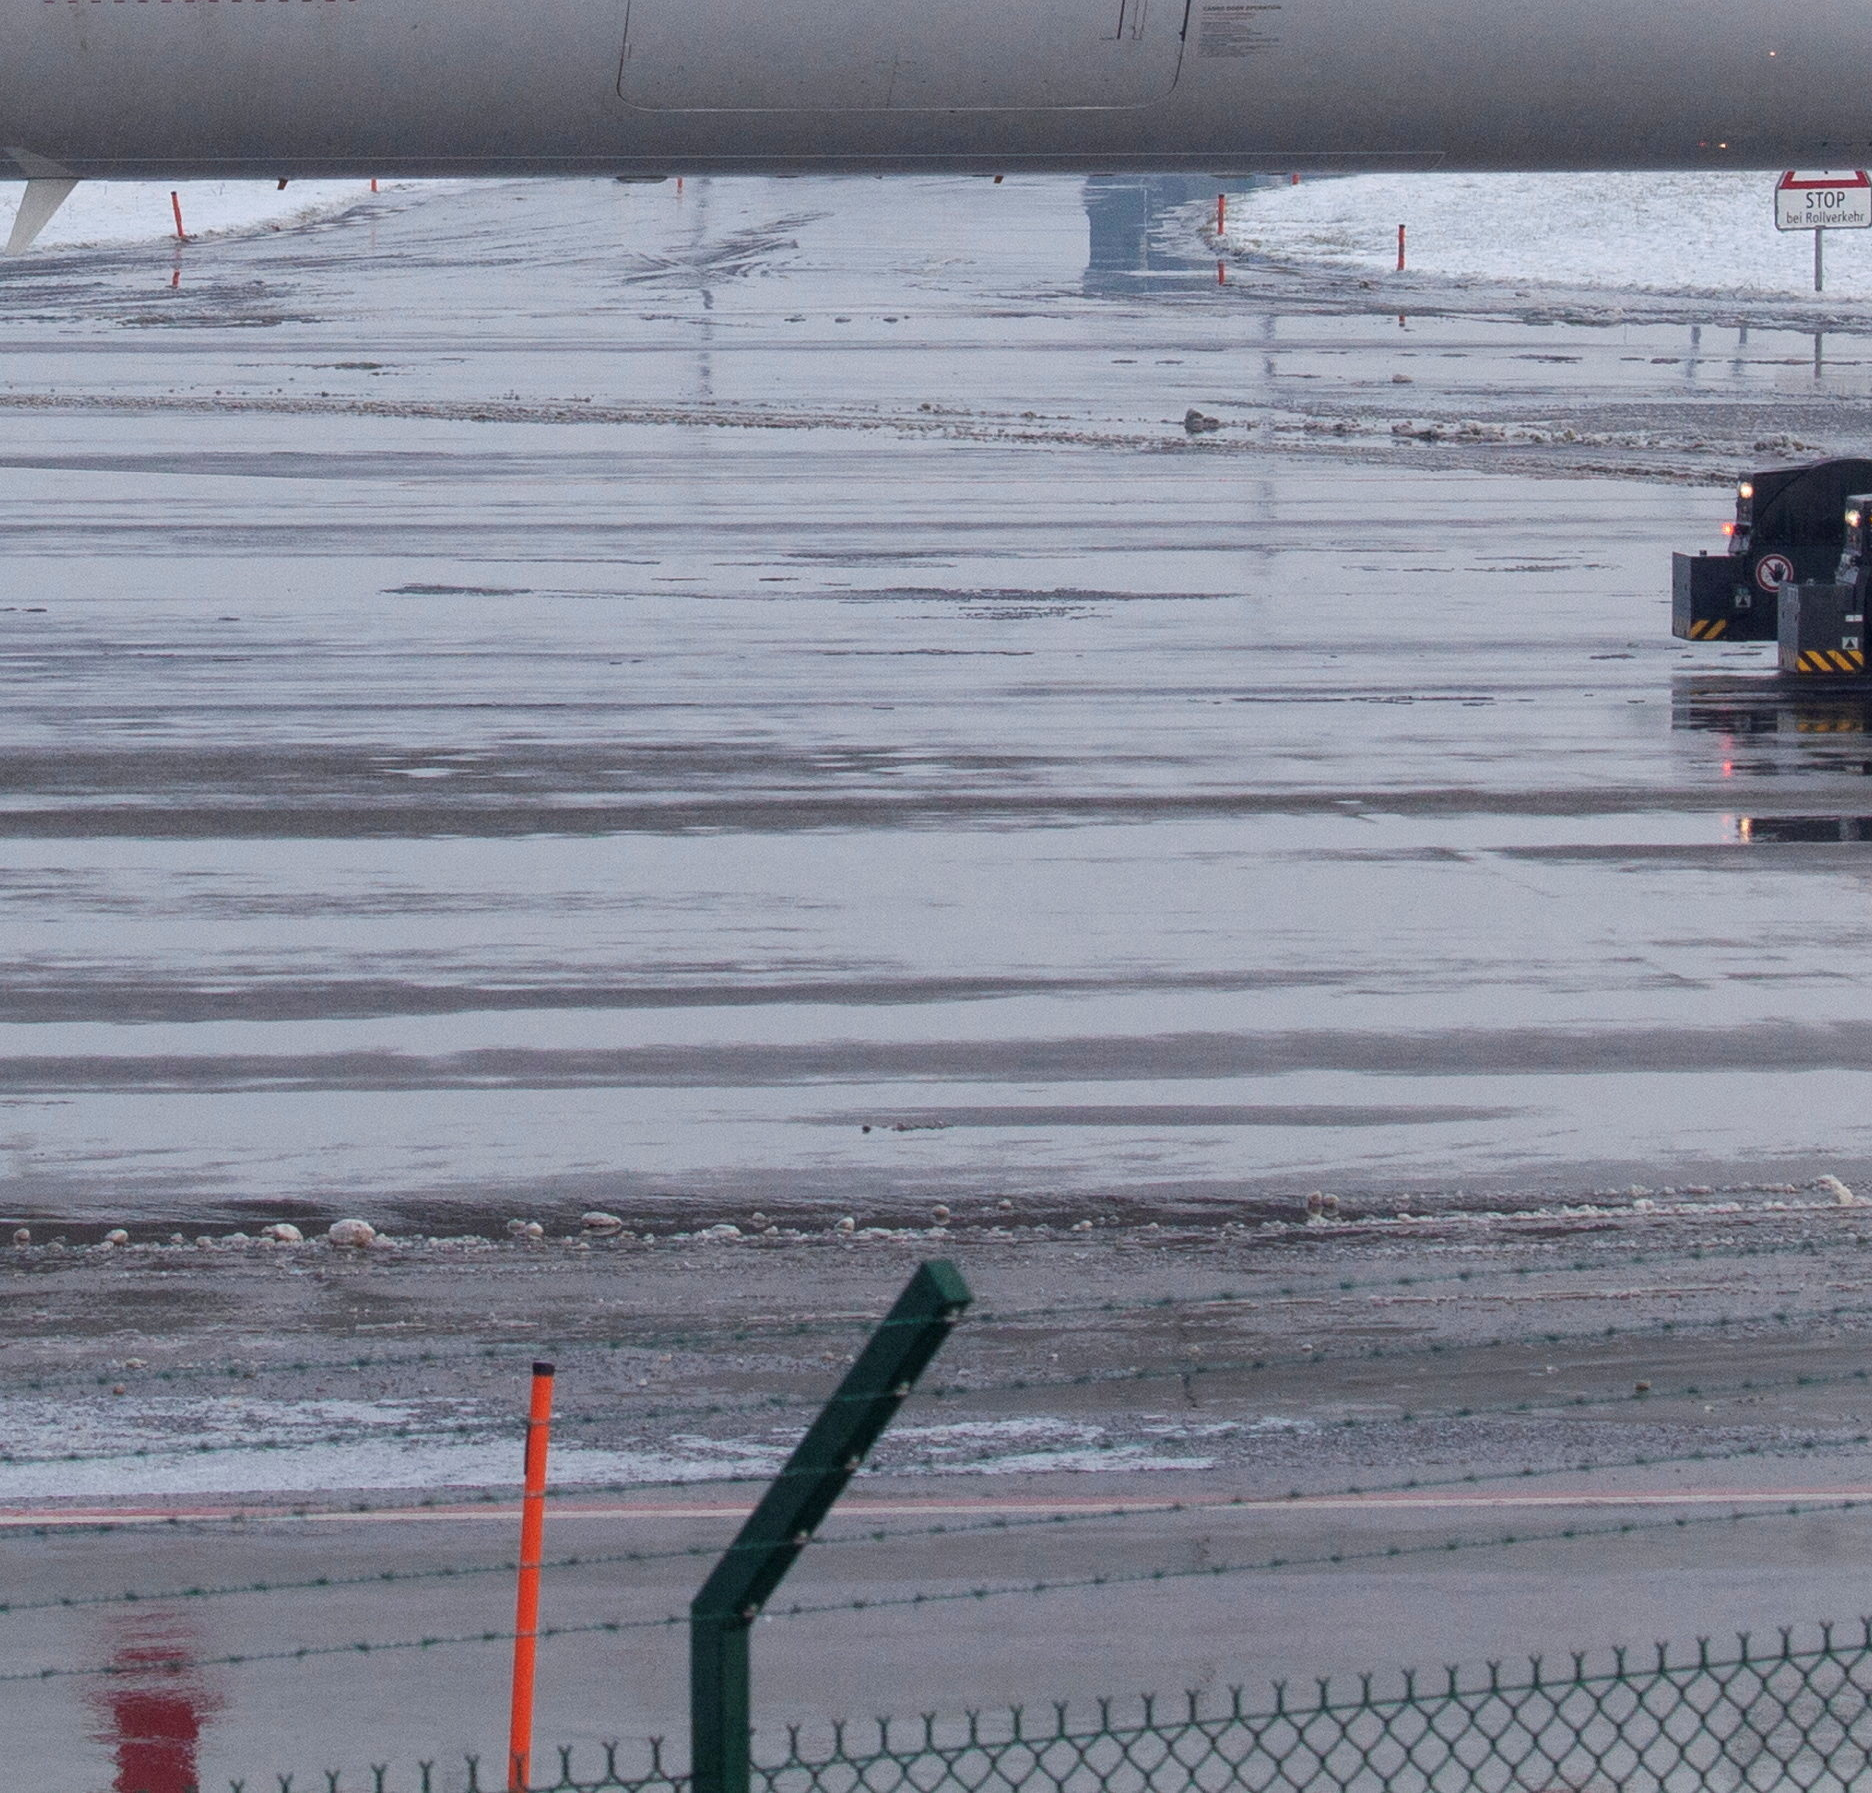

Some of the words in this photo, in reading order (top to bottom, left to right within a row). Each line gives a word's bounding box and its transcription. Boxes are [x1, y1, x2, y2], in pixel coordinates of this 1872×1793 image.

[1805, 191, 1846, 209] STOP
[1786, 211, 1803, 224] bei
[1805, 210, 1866, 224] Rollverkehr
